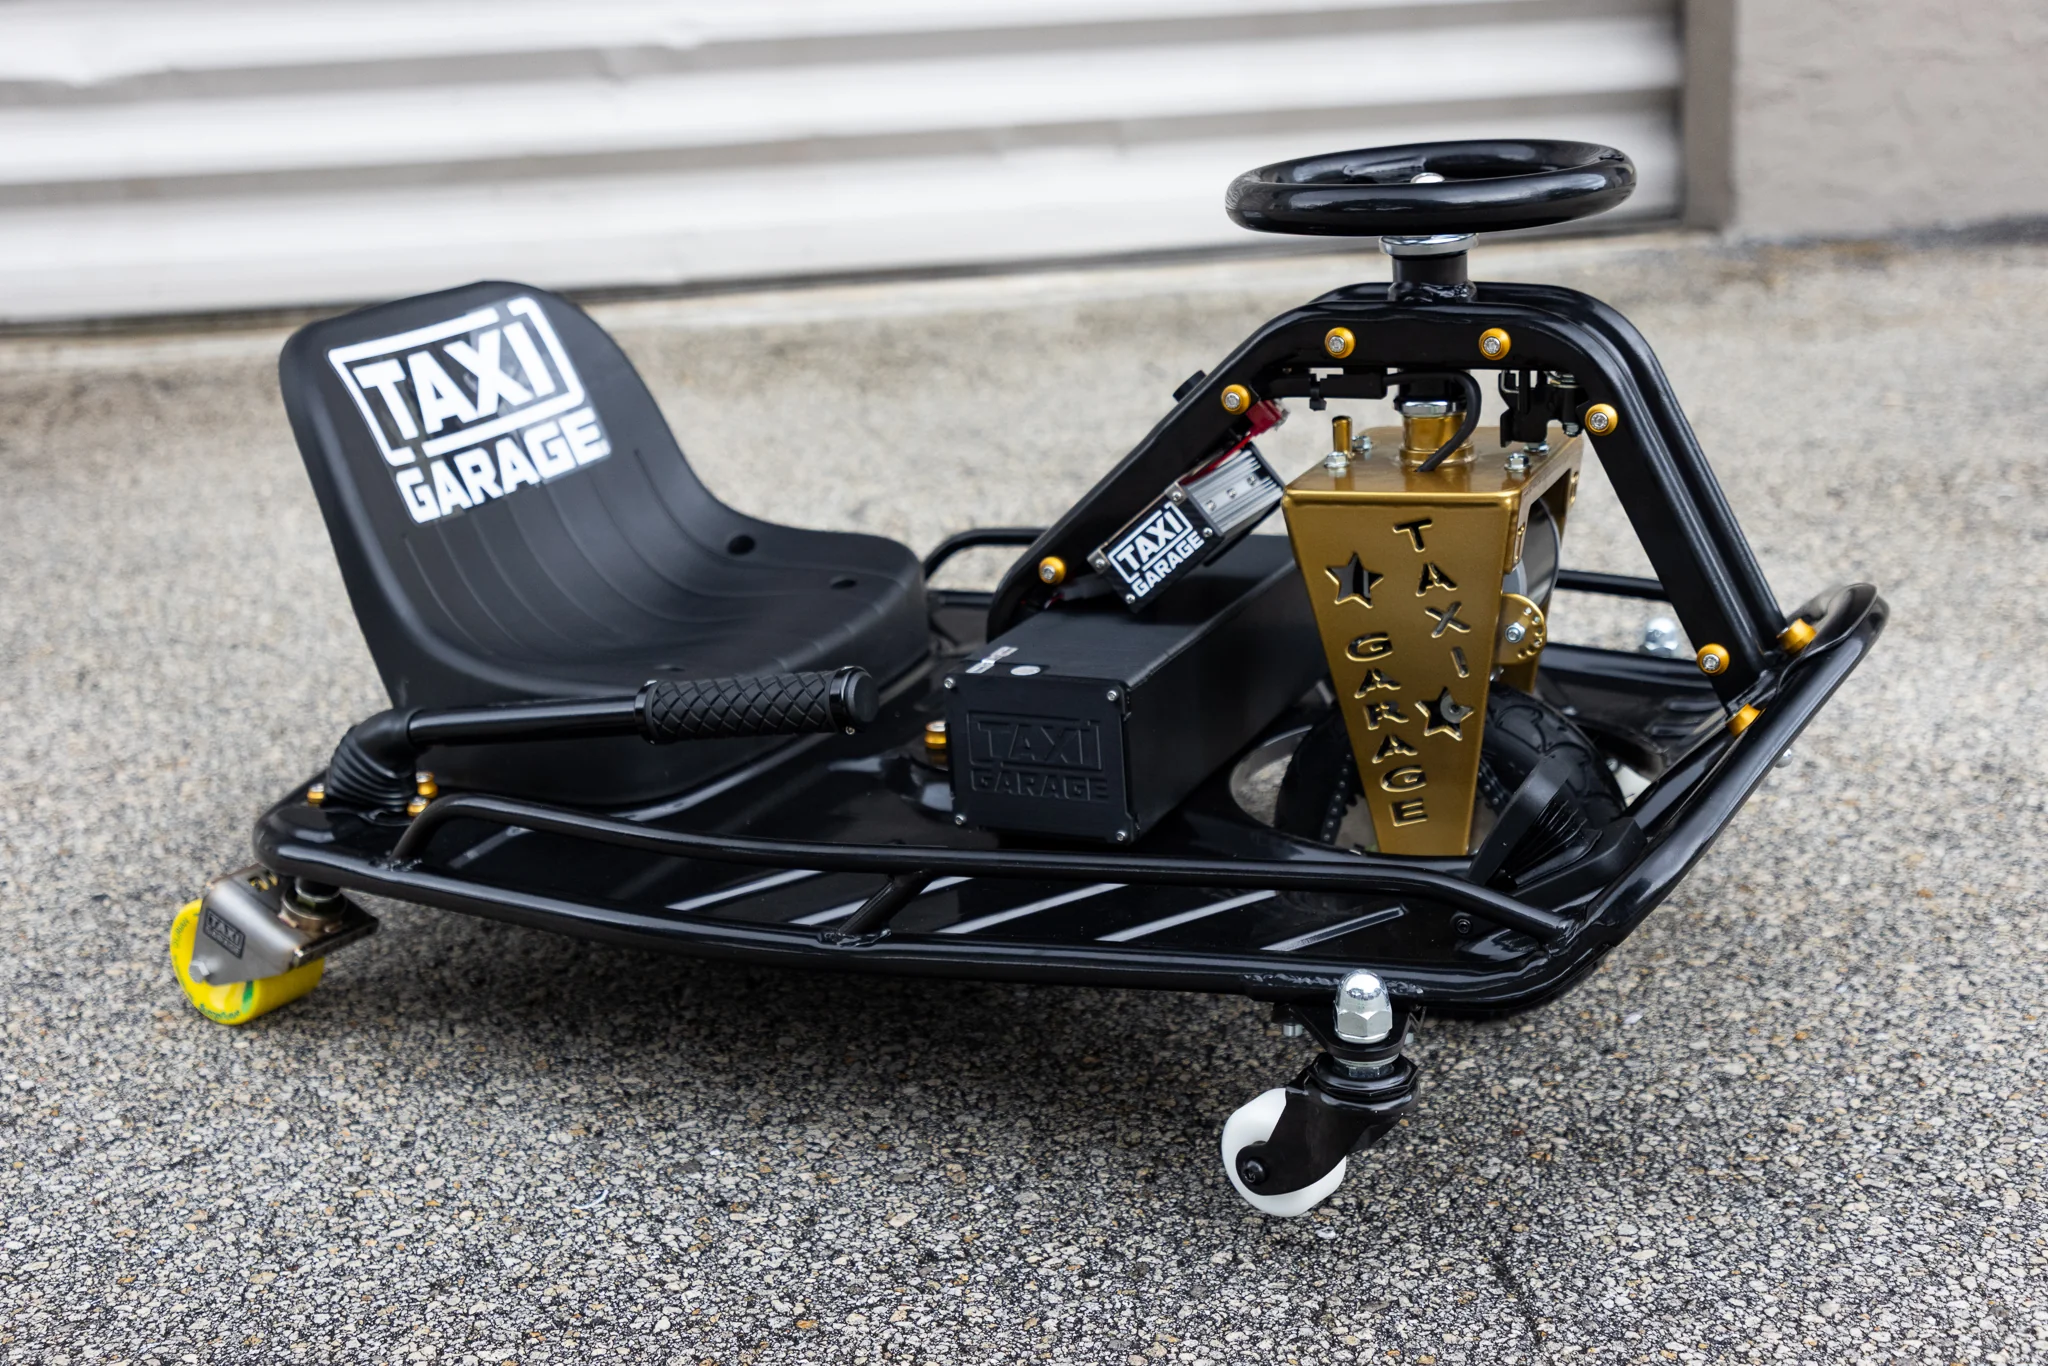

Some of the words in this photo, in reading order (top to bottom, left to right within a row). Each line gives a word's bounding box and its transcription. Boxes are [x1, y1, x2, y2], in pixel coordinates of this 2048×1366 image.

[353, 321, 556, 440] TAXI
[396, 407, 611, 523] GARAGE
[1117, 511, 1184, 571] TAXI
[1131, 531, 1205, 597] GARAGE
[1392, 518, 1471, 678] TAXI
[976, 720, 1092, 766] TAXI
[1345, 632, 1428, 827] GARAGE
[971, 768, 1109, 803] GARAGE
[208, 914, 241, 944] TAXI
